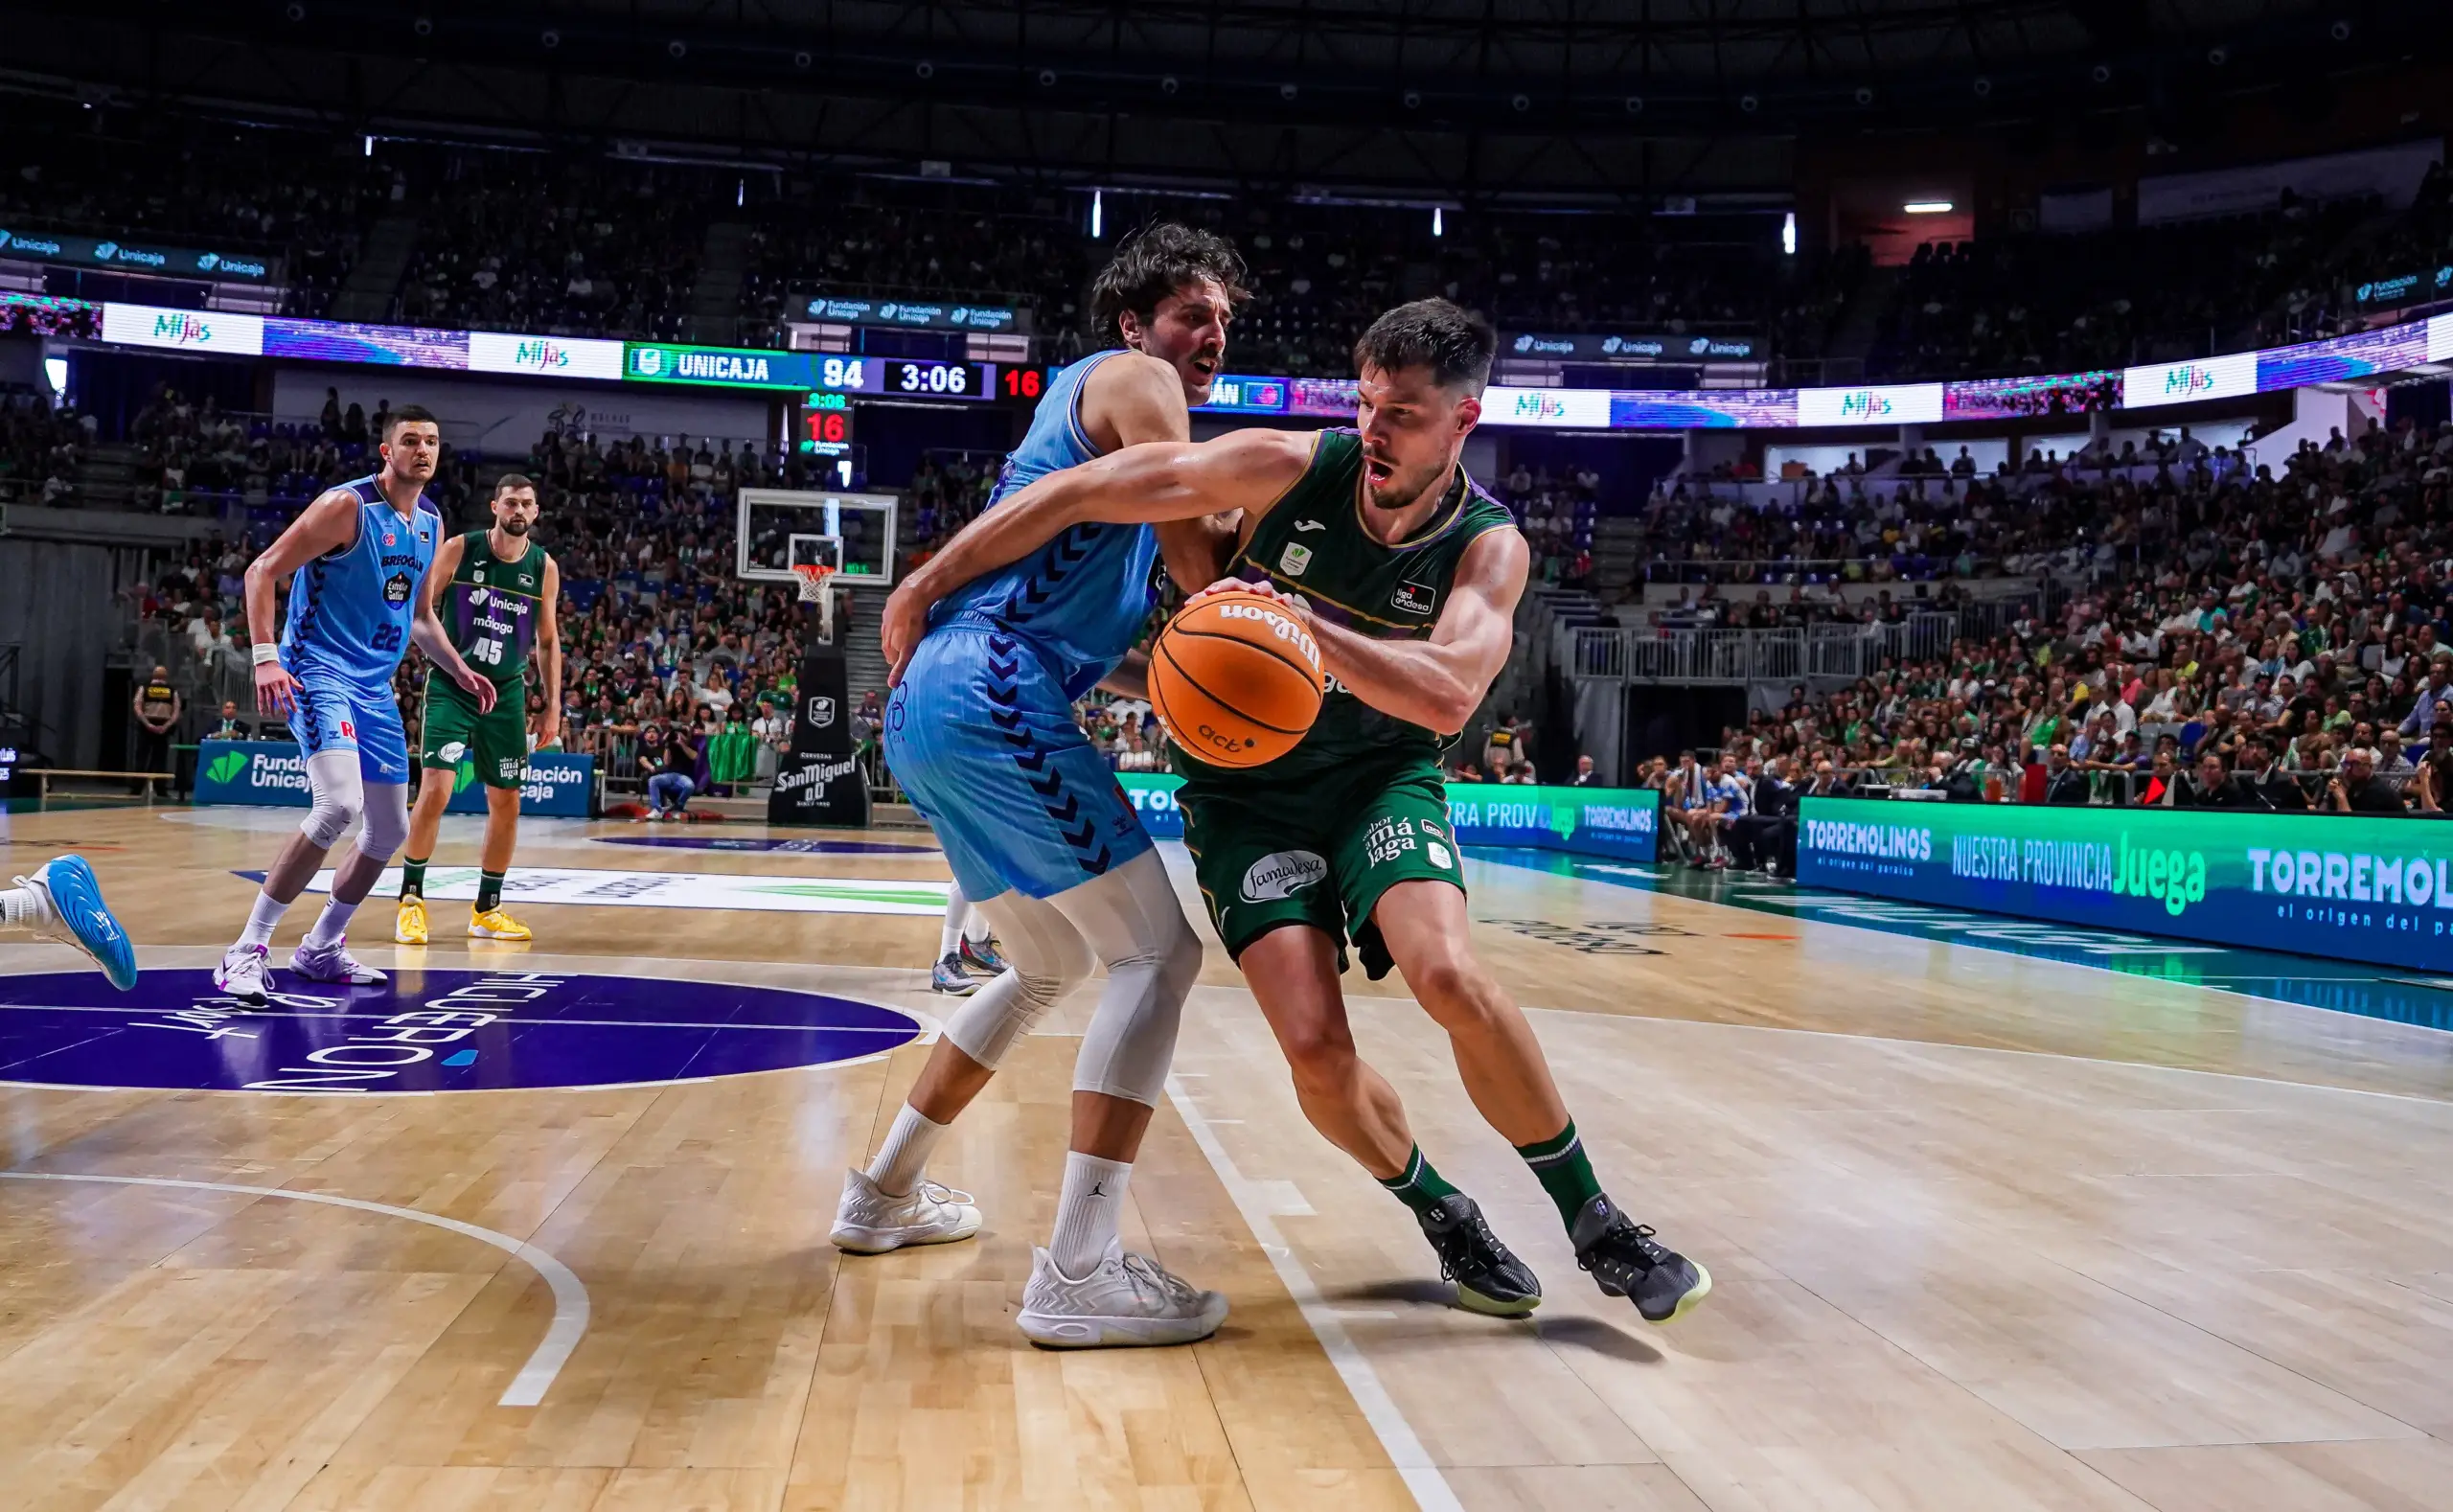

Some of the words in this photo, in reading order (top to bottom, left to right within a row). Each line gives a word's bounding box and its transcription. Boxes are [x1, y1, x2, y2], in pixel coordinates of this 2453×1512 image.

[11, 237, 60, 255] Unicaja
[118, 248, 166, 265] Unicaja
[220, 259, 265, 277] Unicaja
[827, 300, 870, 311] Fundación
[827, 309, 860, 319] Unicaja
[898, 305, 942, 315] Fundación
[970, 309, 1012, 320] Fundación
[898, 313, 930, 324] Unicaja
[969, 316, 1000, 328] Unicaja
[153, 312, 211, 345] Mijas
[515, 340, 569, 371] Mijas
[1534, 339, 1573, 355] Unicaja
[1621, 340, 1662, 356] Unicaja
[1709, 341, 1751, 357] Unicaja
[678, 353, 769, 381] UNICAJA
[823, 358, 864, 389] 94
[901, 364, 966, 393] 3:06
[1005, 370, 1040, 398] 16
[2165, 364, 2214, 398] Mijas
[808, 392, 846, 410] 3:06
[1516, 392, 1566, 421] Mijas
[1841, 391, 1892, 421] Mijas
[806, 412, 844, 443] 16
[1397, 588, 1412, 600] liga
[490, 596, 529, 616] Unicaja
[1395, 597, 1430, 611] endesa
[372, 623, 401, 652] 22
[1219, 604, 1321, 675] Wilson
[472, 636, 503, 666] 45
[252, 753, 307, 771] Funda
[800, 751, 833, 761] CERVEZAS
[251, 769, 311, 794] Unicaj
[527, 765, 583, 784] ación
[1583, 804, 1652, 834] TORREMOLINOS
[1807, 819, 1932, 860] TORREMOLINOS
[1249, 854, 1322, 898] famadesa
[1952, 834, 2019, 882] NUESTRA
[2023, 837, 2114, 892] PROVINCIA
[2113, 830, 2206, 917] Juega
[2247, 846, 2453, 909] TORREMOL
[2386, 913, 2419, 931] del
